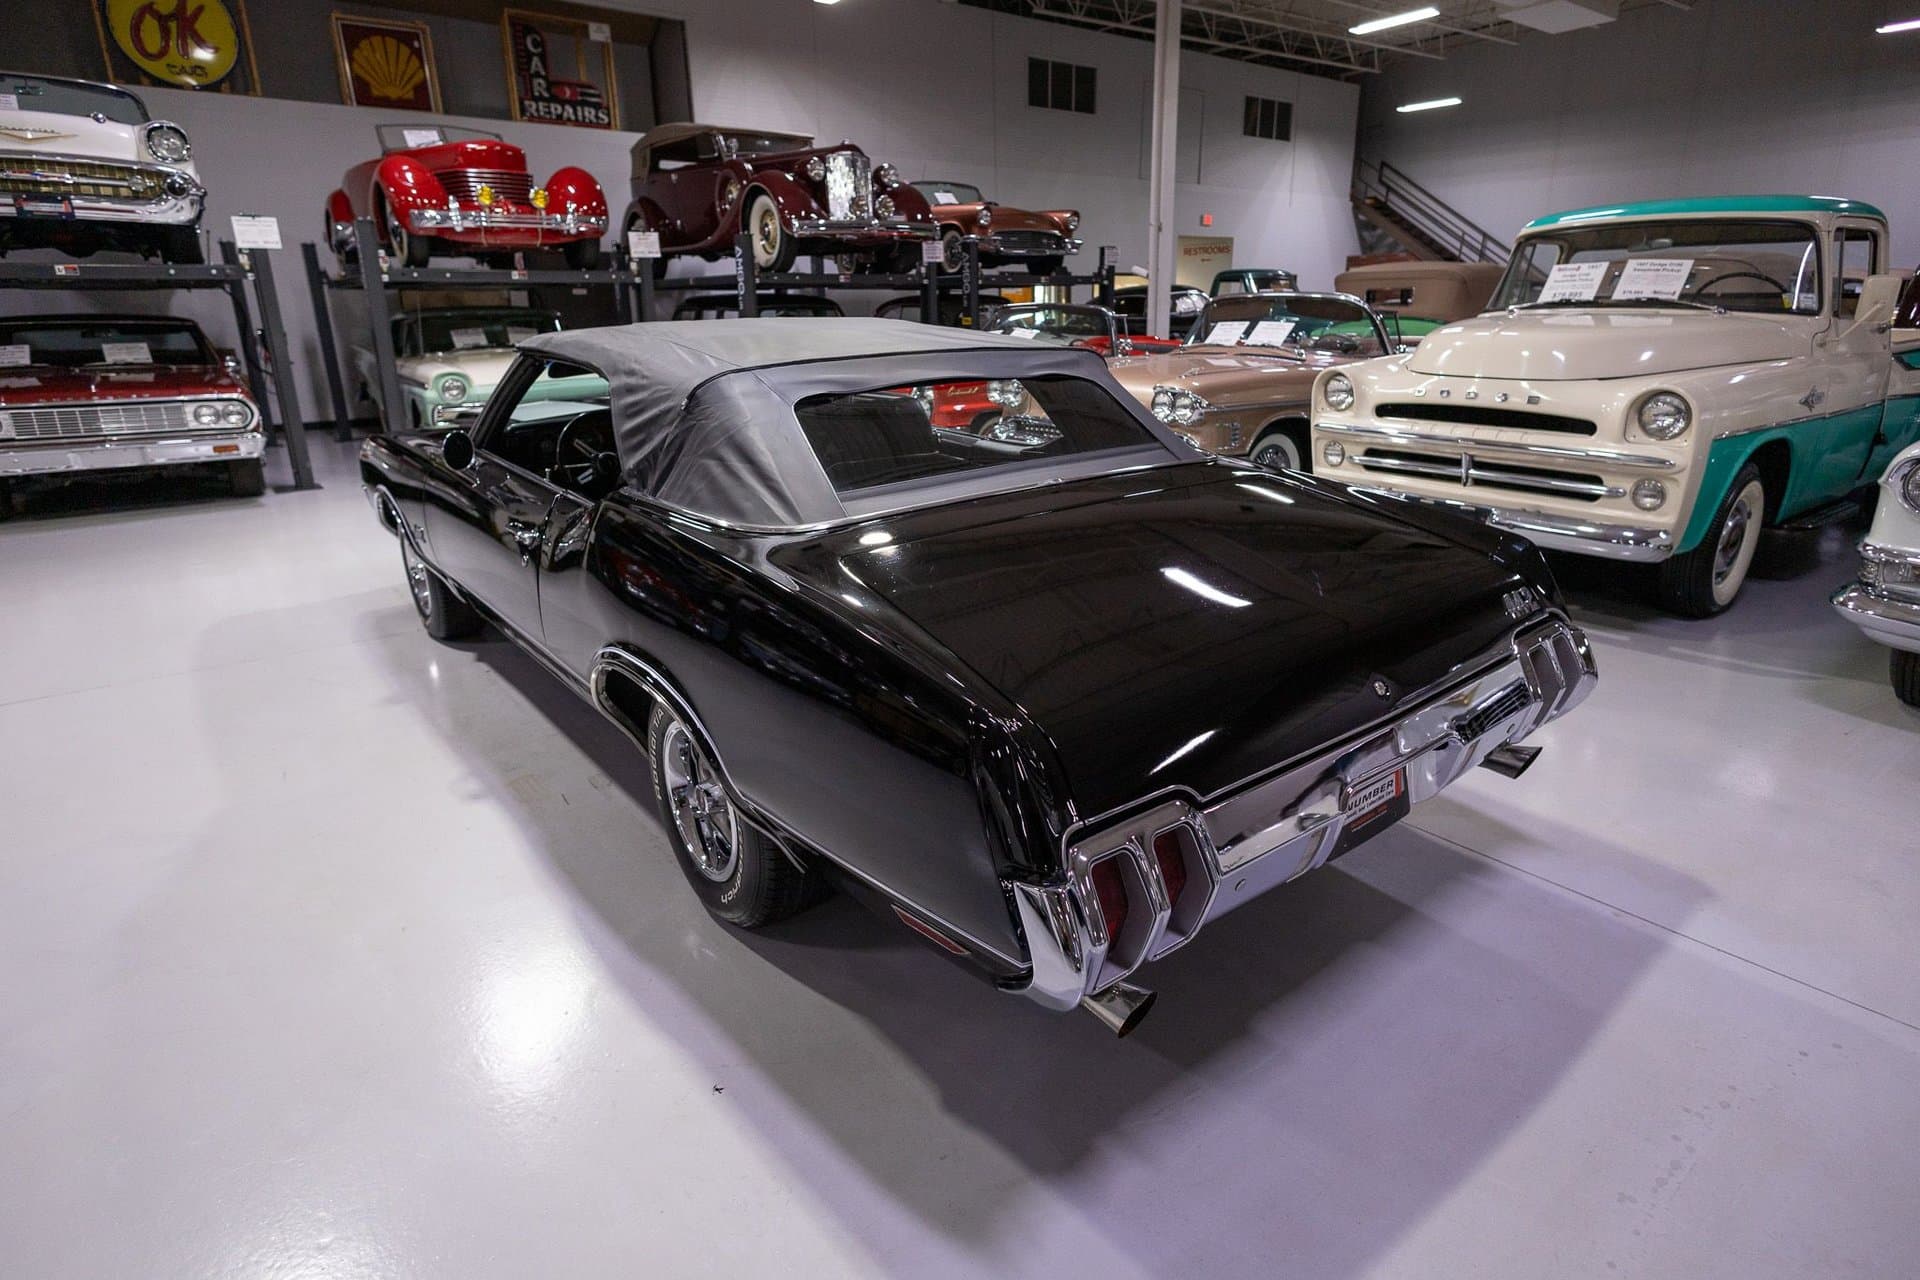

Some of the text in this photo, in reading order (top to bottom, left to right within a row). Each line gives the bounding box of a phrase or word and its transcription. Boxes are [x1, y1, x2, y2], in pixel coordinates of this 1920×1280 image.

[130, 0, 220, 62] OK
[526, 33, 551, 98] CAR
[523, 100, 610, 125] REPAIRS
